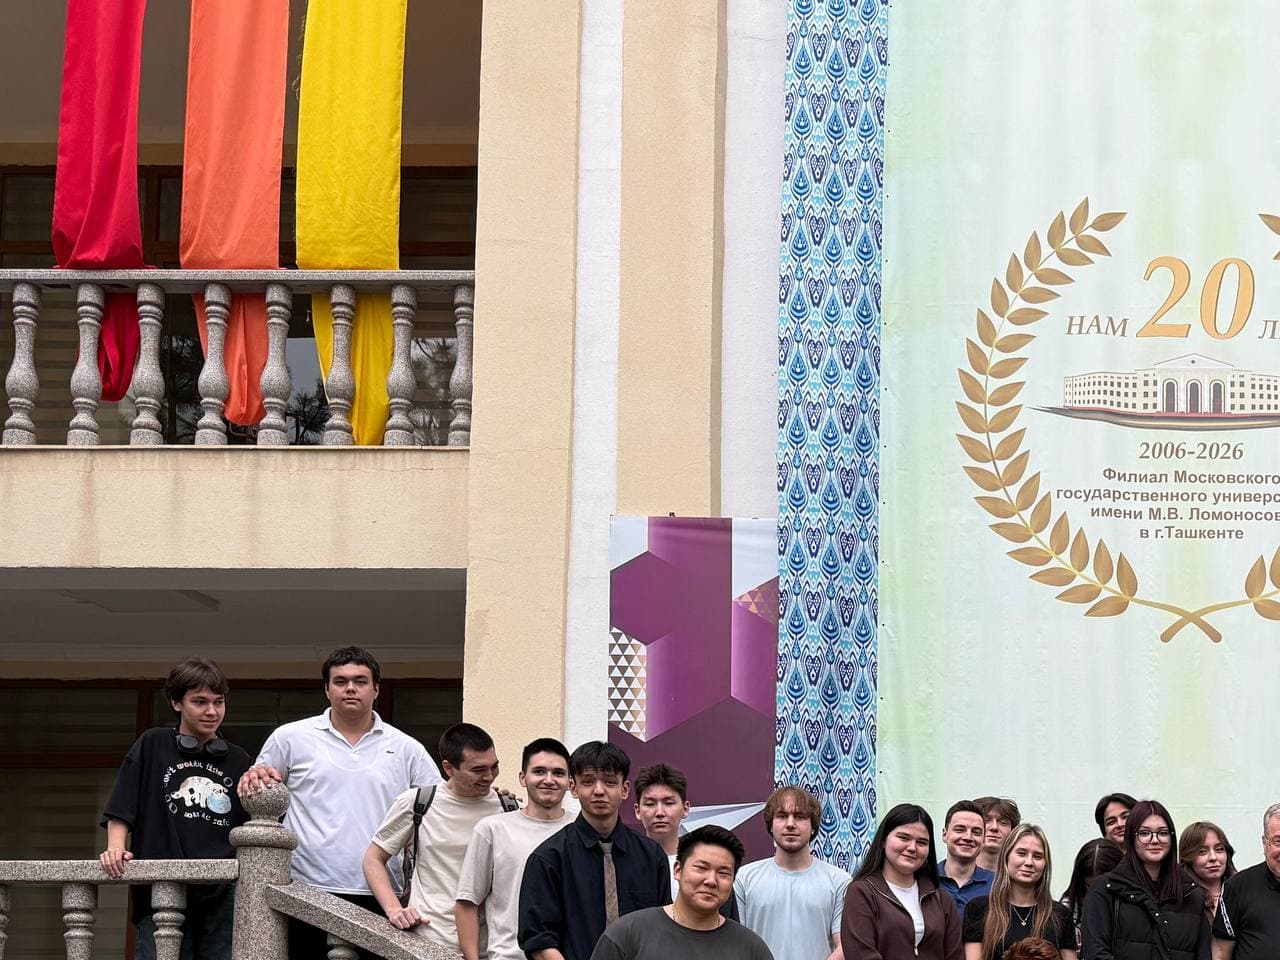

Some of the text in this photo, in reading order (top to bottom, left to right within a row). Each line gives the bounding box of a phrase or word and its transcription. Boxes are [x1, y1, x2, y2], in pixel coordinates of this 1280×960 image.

[1064, 314, 1129, 338] НАМ
[1136, 256, 1255, 340] 20
[1138, 441, 1244, 460] 2006-2026
[1102, 467, 1280, 485] Филиал Московского
[1056, 488, 1208, 503] государственного
[1090, 507, 1143, 520] имени
[1148, 507, 1183, 520] М.В.
[1139, 526, 1244, 540] в г.Ташкенте
